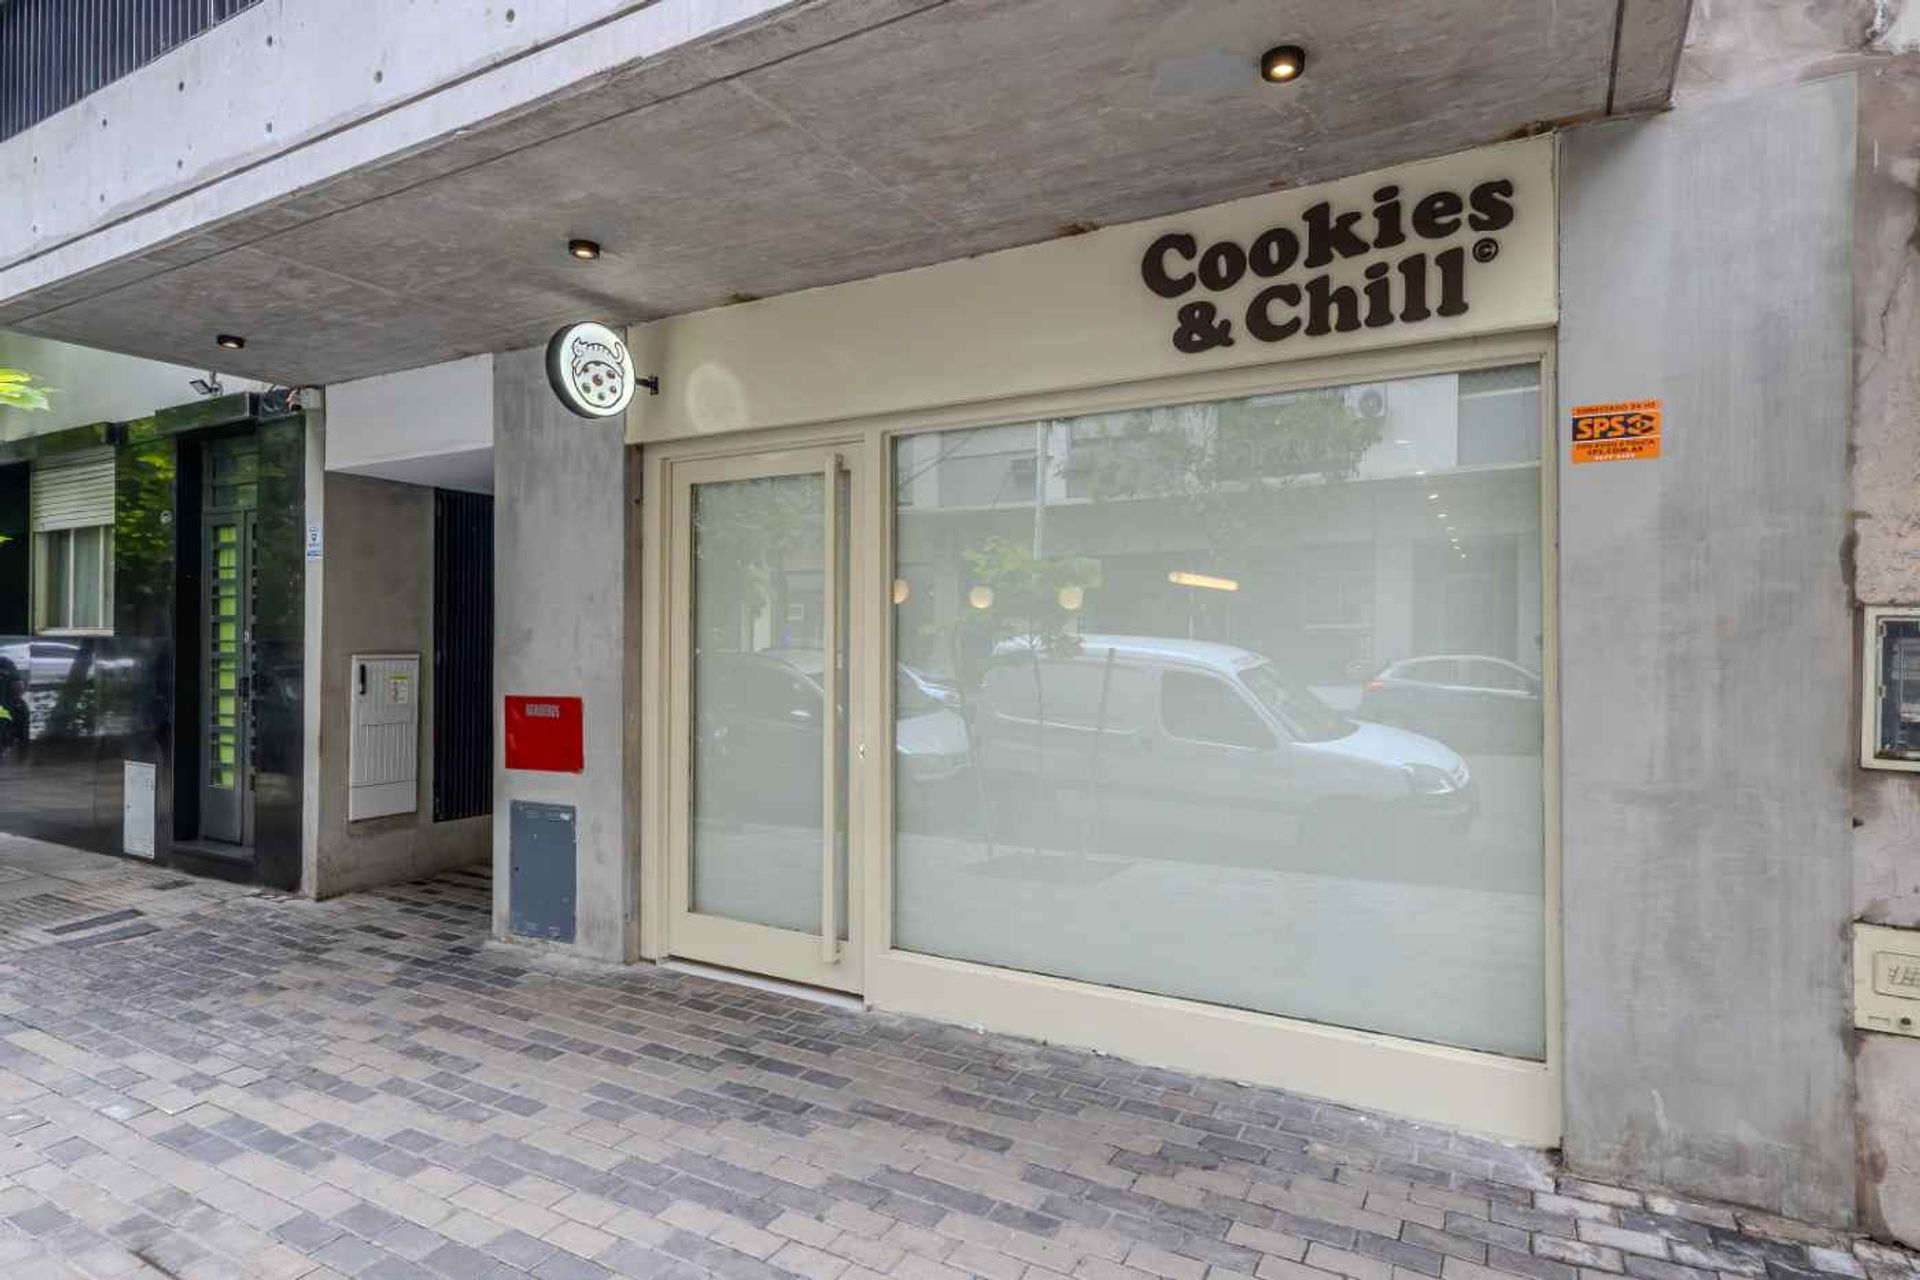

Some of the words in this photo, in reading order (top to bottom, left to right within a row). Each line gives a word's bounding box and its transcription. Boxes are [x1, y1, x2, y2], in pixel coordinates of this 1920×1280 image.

[1141, 179, 1514, 298] Cookies
[1172, 301, 1235, 353] &
[1245, 247, 1469, 342] Chill
[1575, 415, 1625, 439] SPS
